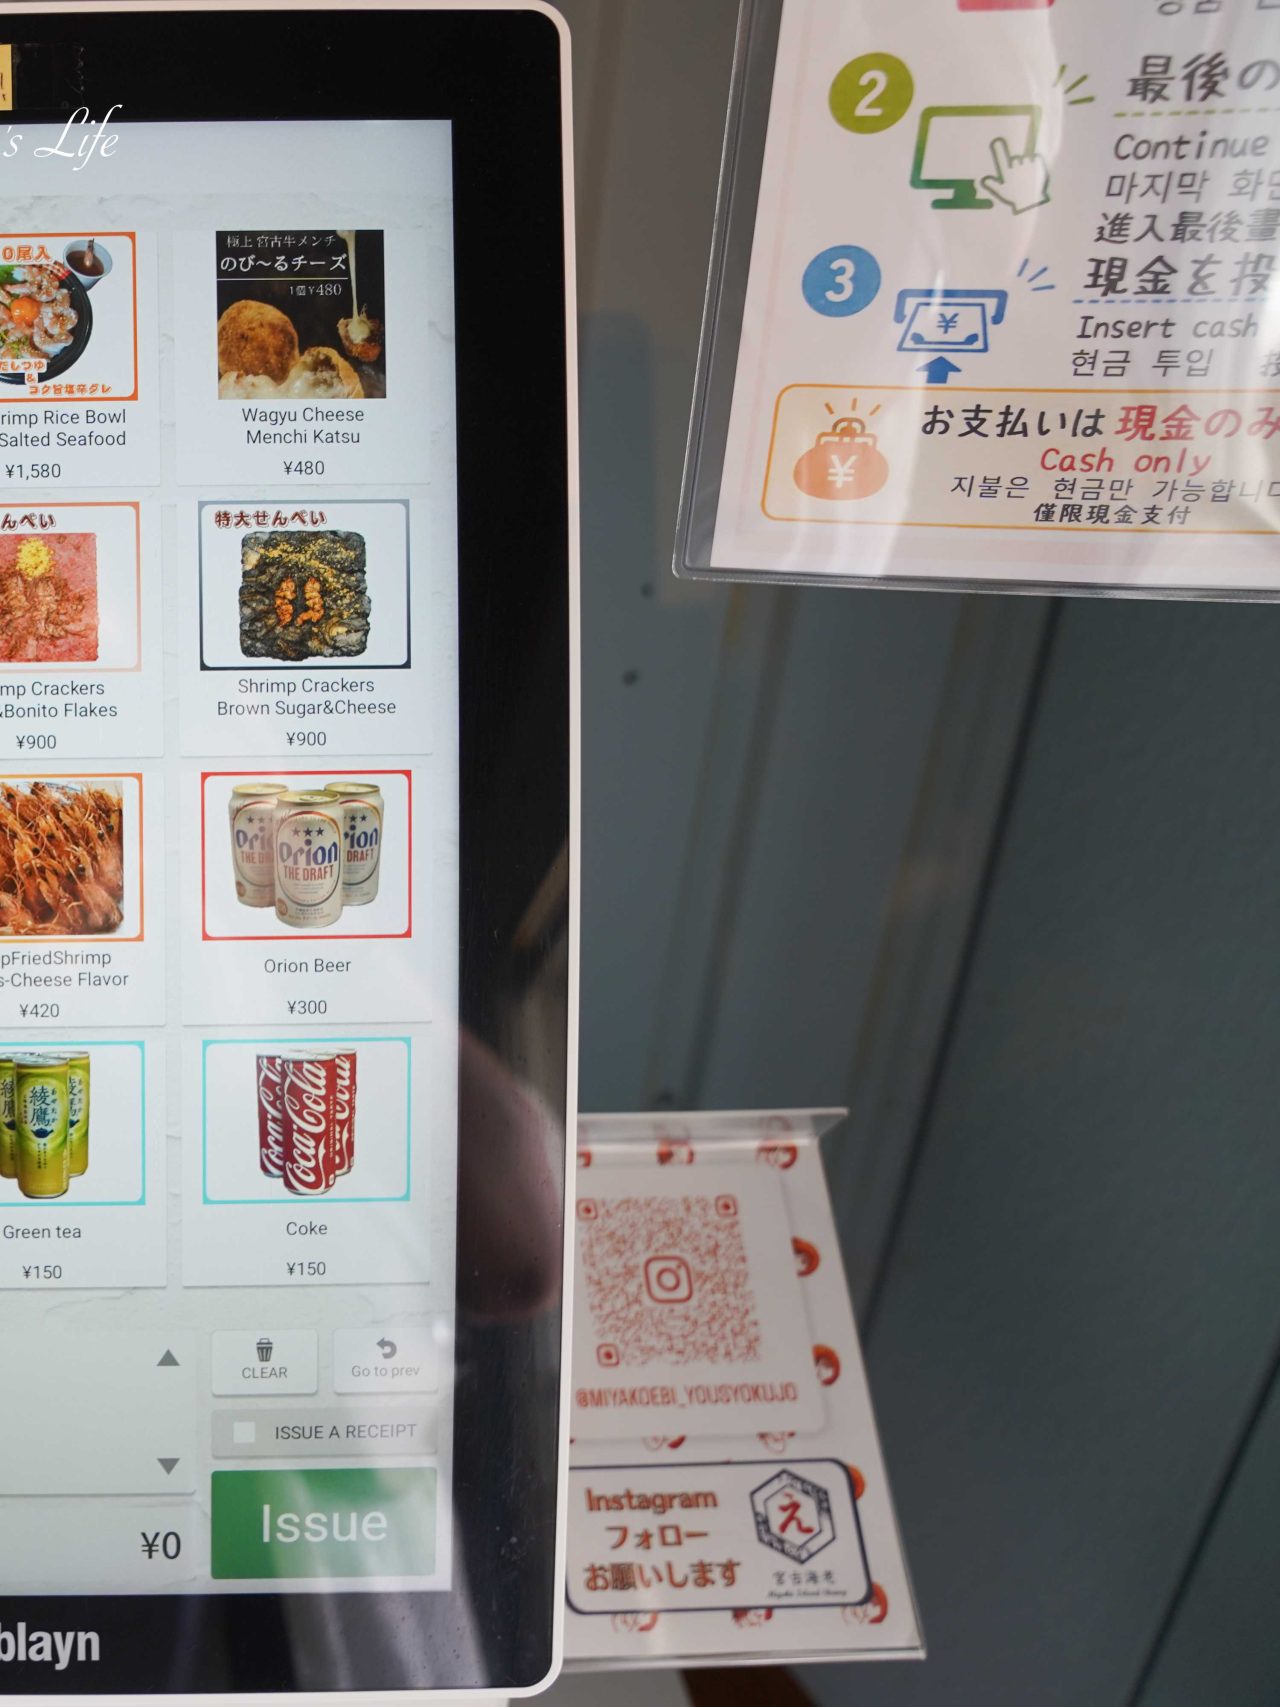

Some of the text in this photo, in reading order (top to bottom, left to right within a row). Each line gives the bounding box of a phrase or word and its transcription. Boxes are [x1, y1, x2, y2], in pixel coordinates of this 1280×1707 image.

[854, 70, 888, 116] 2
[1114, 130, 1270, 161] Continue
[1105, 169, 1211, 205] 마지막
[824, 258, 856, 303] 3
[1076, 312, 1260, 339] Insert cash
[1072, 348, 1215, 378] 현금 투입
[44, 410, 80, 425] Rice
[86, 408, 126, 424] Bowl
[242, 406, 365, 426] Wagyu Cheese
[56, 430, 126, 447] Seafood
[246, 428, 361, 445] Menchi Katsu
[283, 460, 326, 476] ¥480
[1039, 447, 1212, 478] Cash only
[5, 463, 62, 481] ¥1,580
[950, 475, 1031, 499] 지불은
[1053, 476, 1135, 501] 현금만
[213, 509, 327, 529] 特大せんべい
[1033, 502, 1192, 526] 僅限現金支付
[31, 680, 105, 696] Crackers
[238, 677, 375, 696] Shrimp Crackers
[64, 702, 118, 718] Flakes
[217, 700, 397, 720] Brown Sugar&Cheese
[15, 734, 58, 750] ¥900
[286, 731, 327, 747] ¥900
[278, 838, 338, 866] Orion
[283, 864, 334, 881] THE DRAFT
[264, 958, 352, 973] Orion Beer
[78, 971, 129, 987] Flavor
[19, 1003, 60, 1018] ¥420
[287, 999, 328, 1015] ¥300
[3, 1224, 82, 1239] Green tea
[286, 1220, 328, 1236] Coke
[22, 1265, 63, 1280] ¥150
[286, 1261, 327, 1277] ¥150
[241, 1366, 288, 1380] CLEAR
[351, 1364, 421, 1381] Go to prev
[275, 1423, 418, 1440] ISSUE A RECEIPT
[586, 1488, 718, 1514] Instagram
[262, 1503, 388, 1543] Issue
[140, 1531, 182, 1560] ¥0
[606, 1525, 709, 1550] フォロー
[584, 1559, 742, 1591] お願いします
